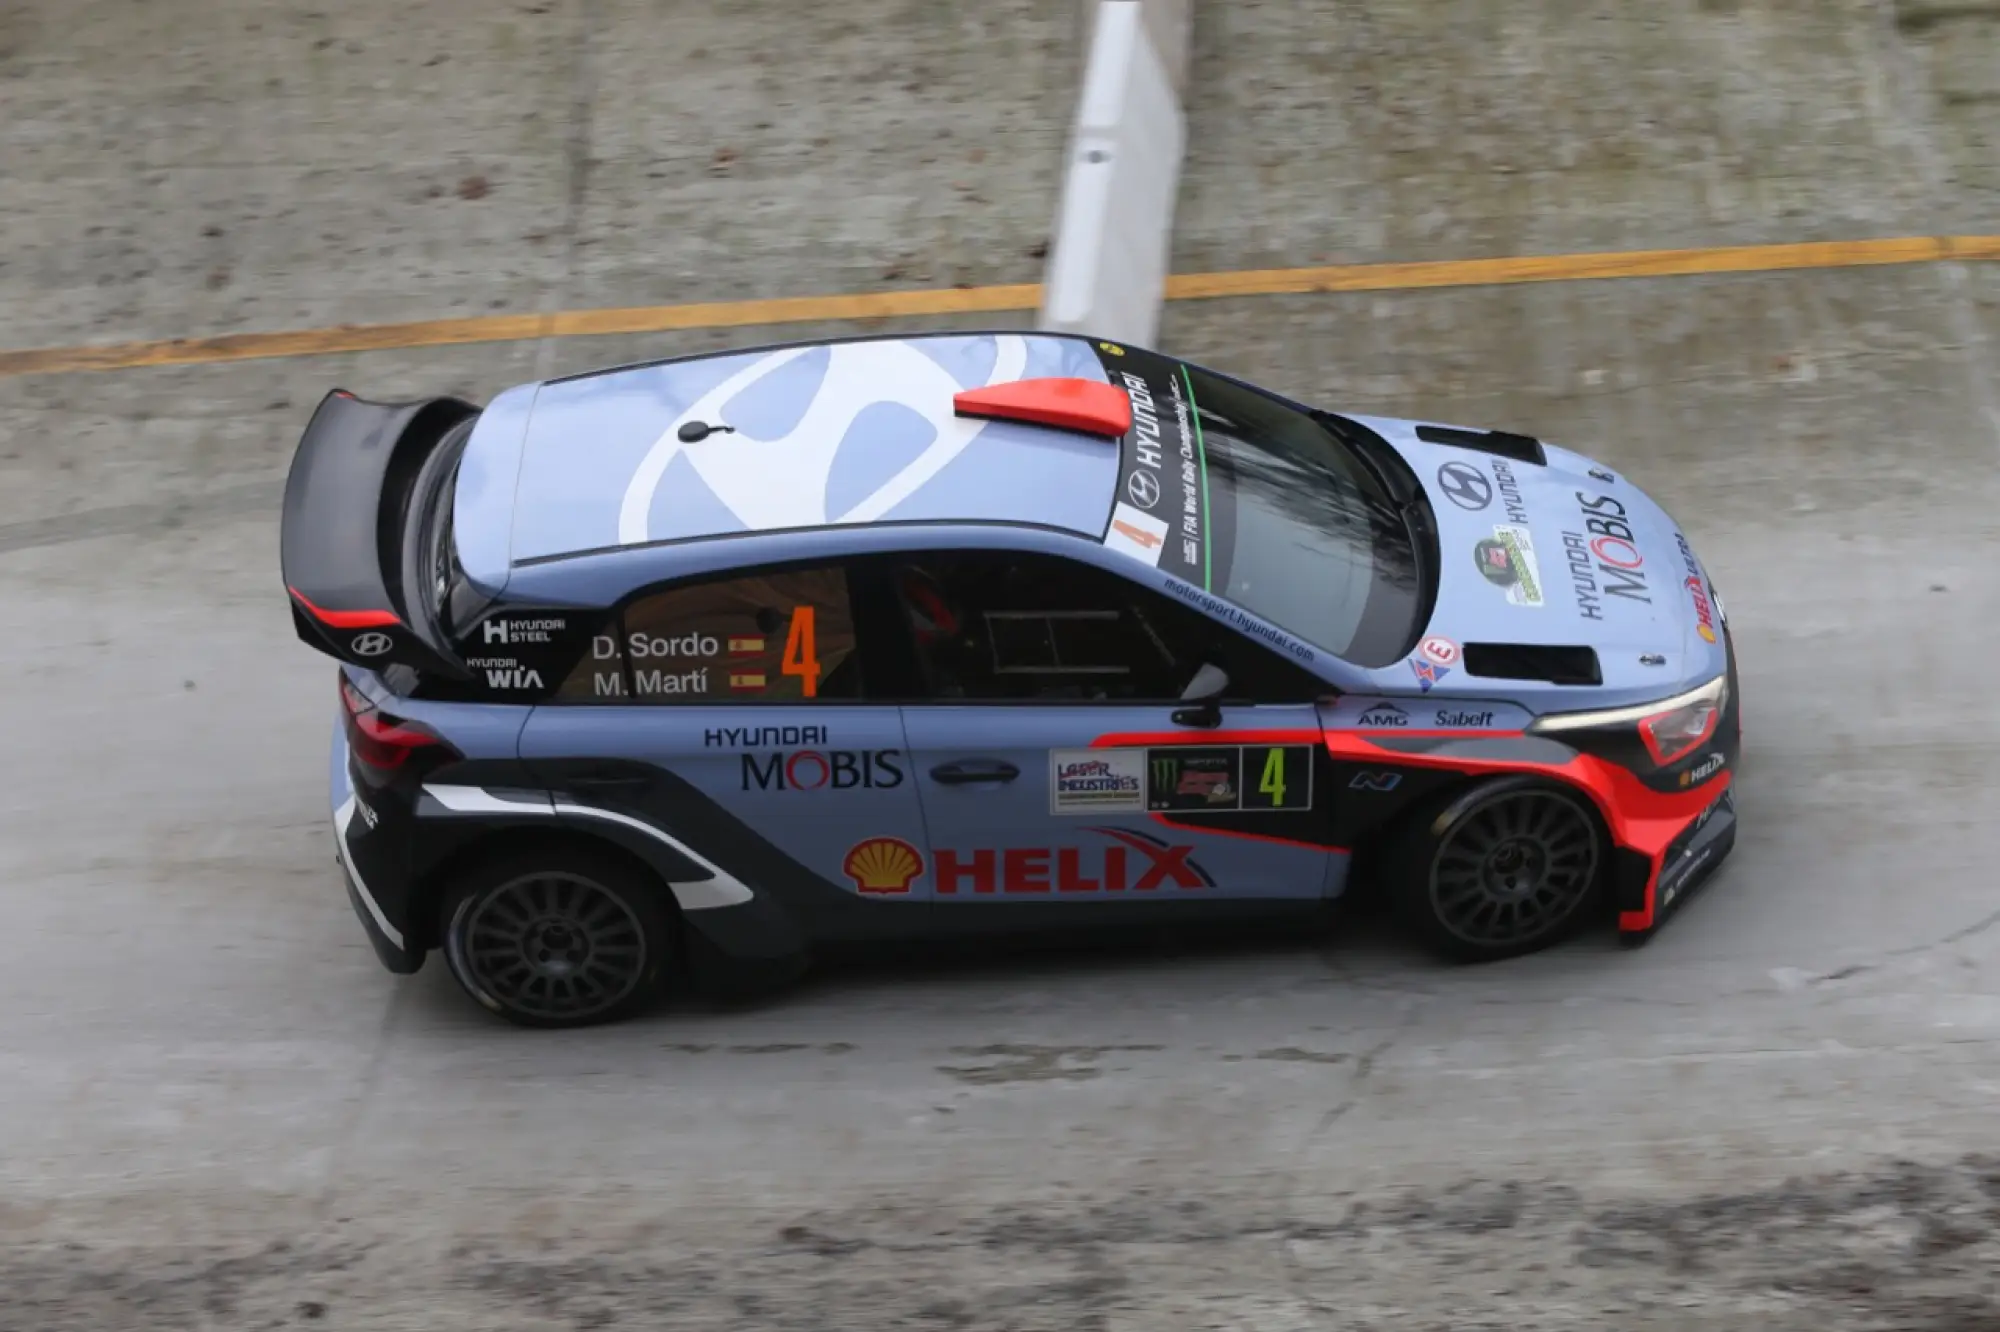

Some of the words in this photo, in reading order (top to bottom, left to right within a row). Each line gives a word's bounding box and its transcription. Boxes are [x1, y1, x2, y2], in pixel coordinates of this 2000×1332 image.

[1120, 371, 1161, 469] HYUNDAI
[1181, 459, 1197, 484] Rally
[1182, 484, 1197, 514] World
[1491, 459, 1529, 524] HYUNDAI
[1113, 519, 1162, 549] 4
[1576, 491, 1652, 605] MOBIS
[1562, 530, 1603, 621] HYUNDAI
[510, 619, 566, 631] HYUNDAI
[1164, 578, 1315, 661] motorsport.hyundai.com
[510, 631, 552, 642] STEEL
[592, 636, 622, 659] D.
[629, 633, 719, 658] Sordo
[781, 605, 821, 698] 4
[466, 657, 517, 668] HYUNDAI
[594, 673, 629, 696] M.
[635, 667, 709, 694] Martí
[1357, 714, 1409, 727] AMG
[1435, 710, 1494, 727] Sabelt
[704, 726, 828, 747] HYUNDAI
[741, 750, 904, 791] MOBIS
[1258, 748, 1287, 807] 4
[933, 840, 1214, 893] HELIX
